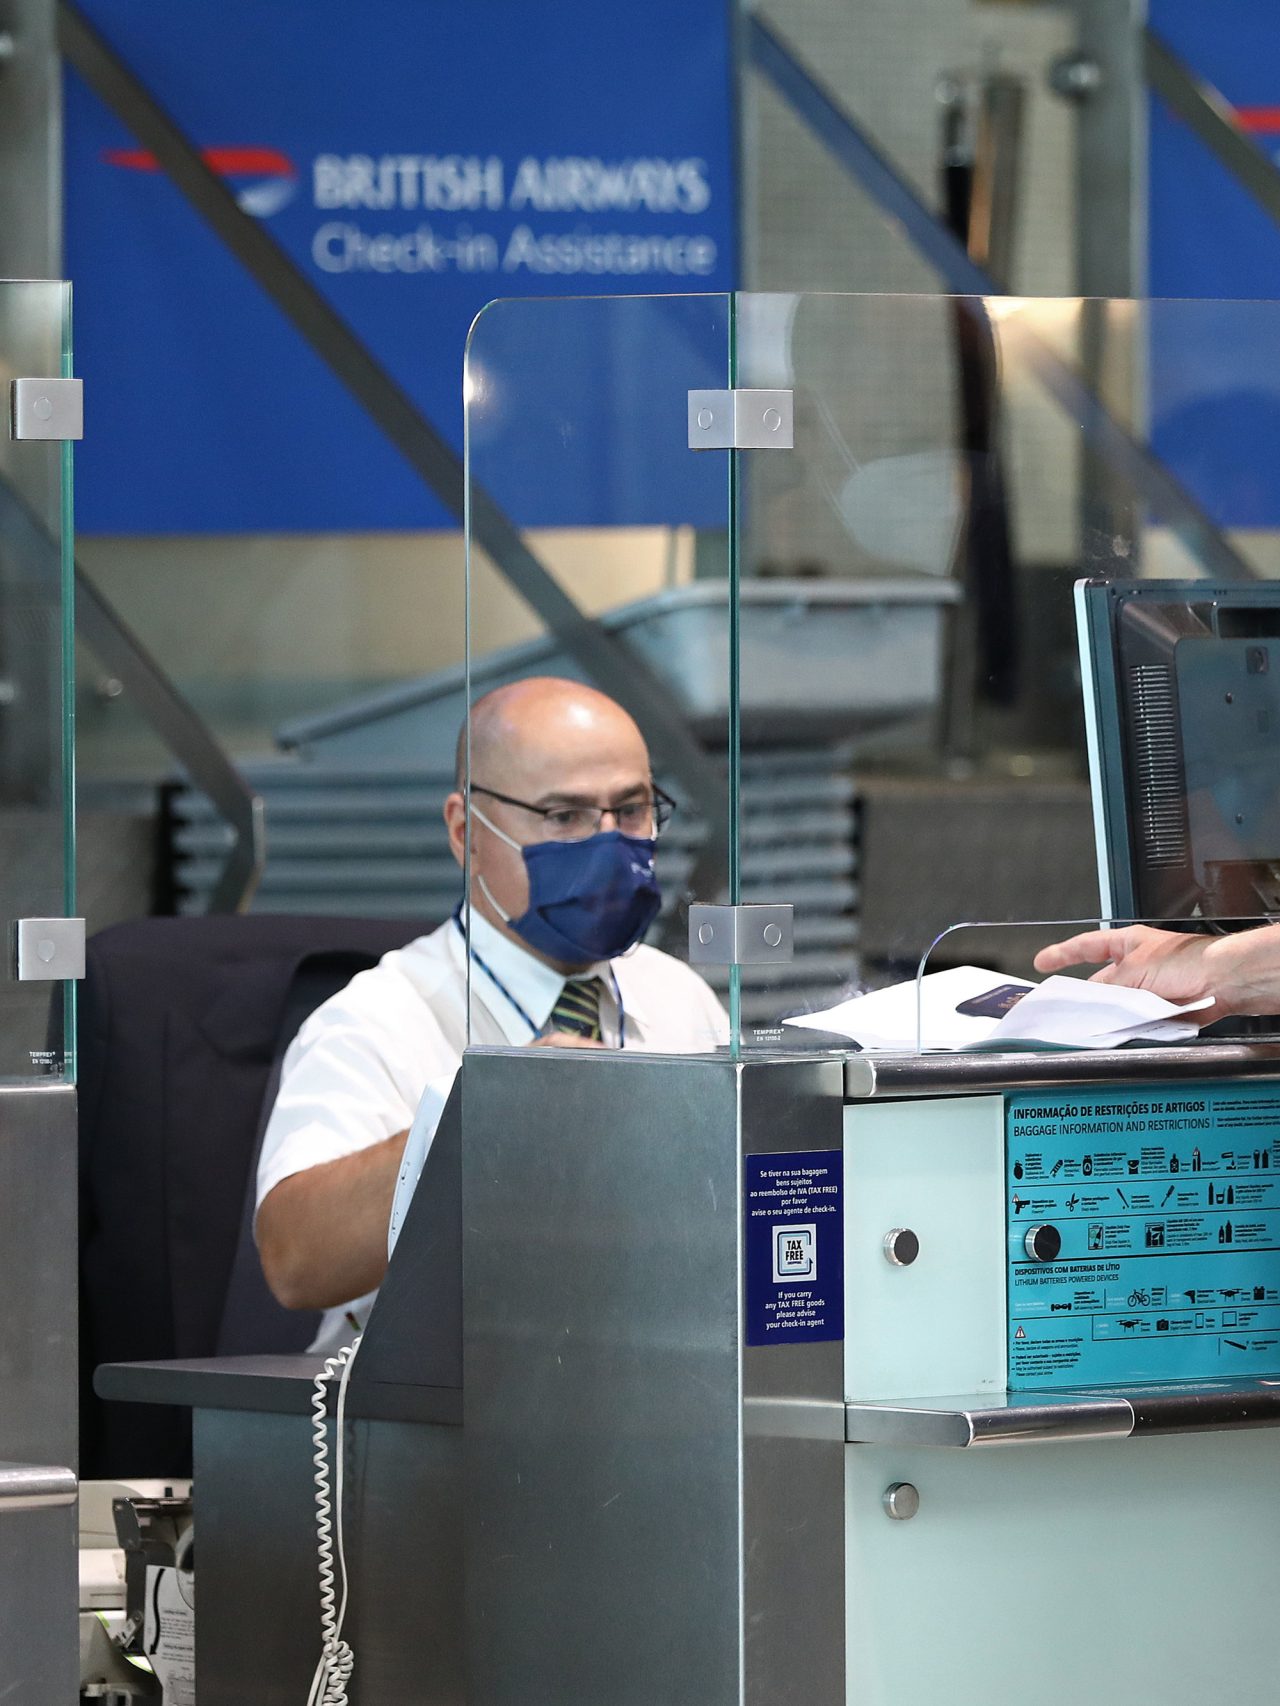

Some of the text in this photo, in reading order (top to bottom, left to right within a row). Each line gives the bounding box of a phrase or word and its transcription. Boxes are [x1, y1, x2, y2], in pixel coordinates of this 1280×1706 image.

[313, 153, 710, 214] BRITISH AIRWAYS
[312, 221, 717, 275] Check-in Assistance
[1014, 1104, 1078, 1121] INFORMAÇÃO
[1081, 1106, 1092, 1117] DE
[1095, 1101, 1149, 1118] RESTRIÇÕES
[1151, 1102, 1163, 1114] DE
[1165, 1101, 1205, 1114] ARTIGOS
[1014, 1124, 1057, 1137] BAGGAGE
[1059, 1121, 1123, 1135] INFORMATION
[1126, 1120, 1145, 1131] AND
[1148, 1117, 1210, 1131] RESTRICTIONS
[801, 1168, 828, 1177] bagagem
[776, 1178, 813, 1187] bens sujeitos
[758, 1188, 788, 1197] reembolso
[781, 1197, 808, 1207] por favor
[783, 1207, 803, 1216] agente
[803, 1206, 811, 1214] de
[787, 1240, 802, 1251] TAX
[785, 1250, 804, 1261] FREE
[1015, 1266, 1053, 1276] DISPOSITIVOS
[1054, 1266, 1069, 1274] COM
[1070, 1264, 1096, 1273] BATERIAS
[1015, 1273, 1119, 1286] LITHIUM BATTERIES POWERED DEVICES
[796, 1291, 812, 1299] carry
[765, 1302, 776, 1310] any
[791, 1299, 805, 1307] FREE
[806, 1299, 825, 1308] goods
[776, 1309, 816, 1319] please advise
[766, 1319, 824, 1330] your check-in agent
